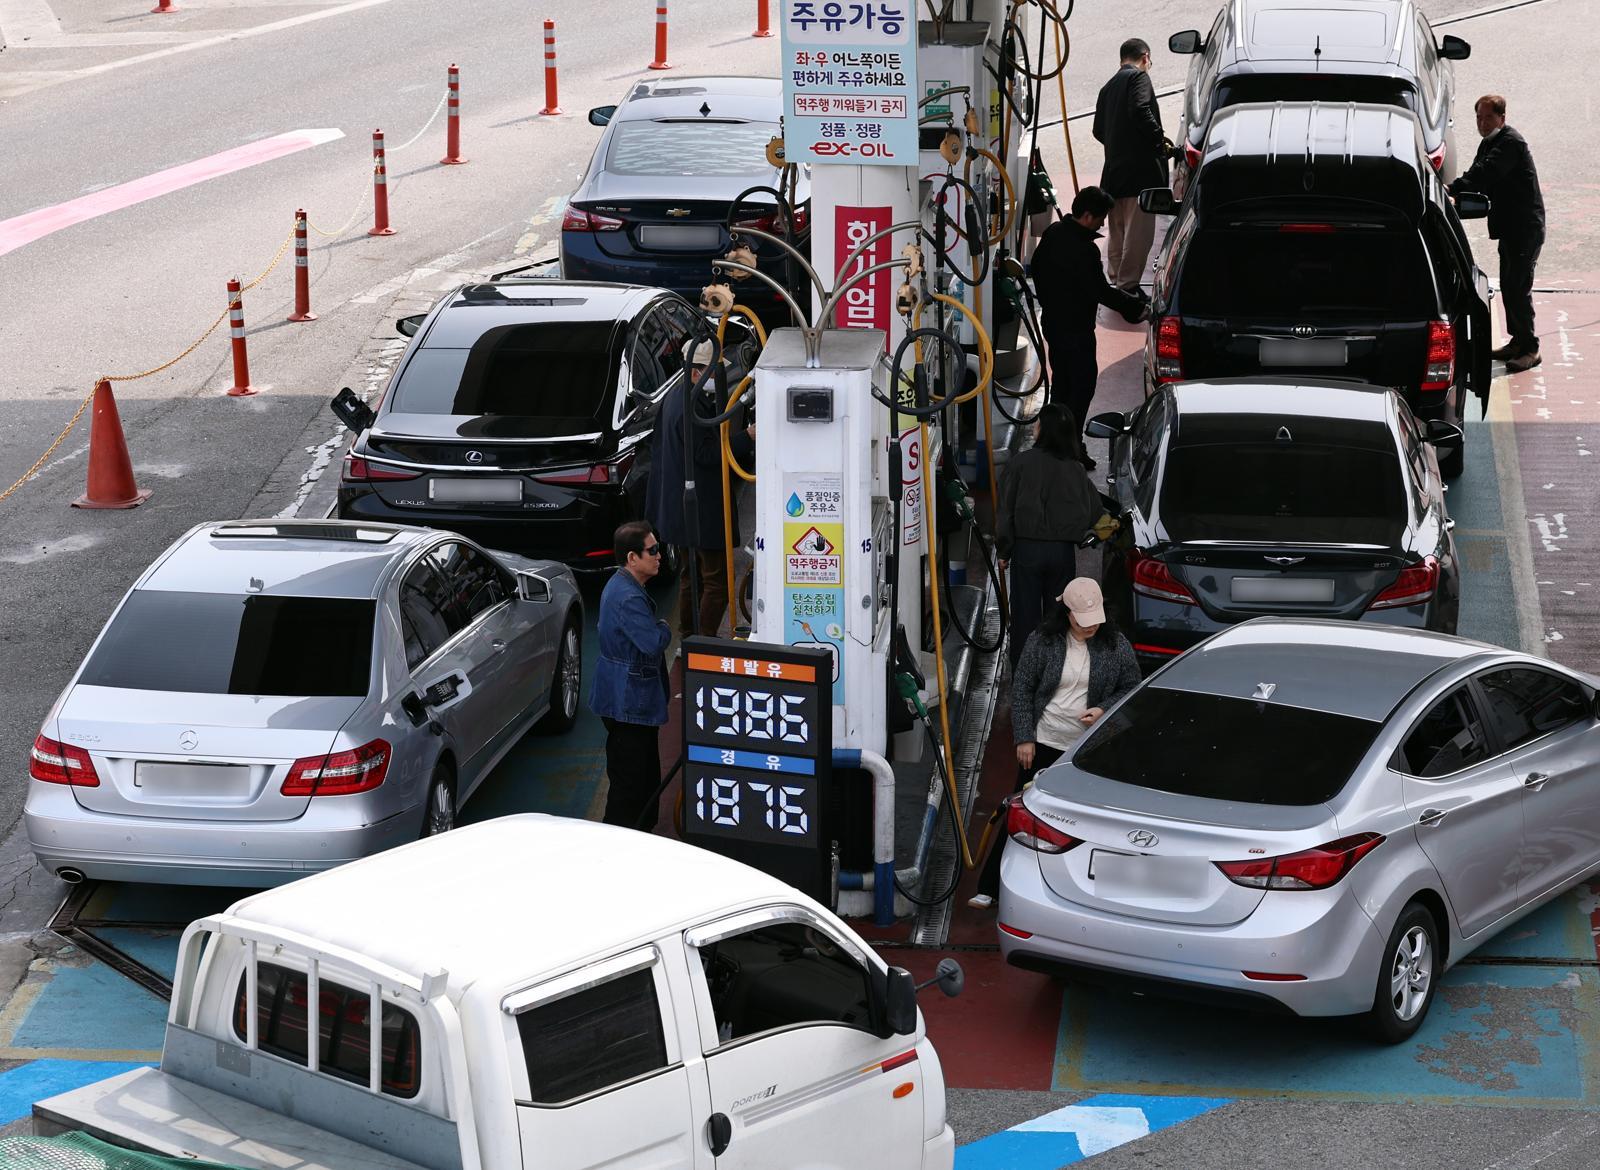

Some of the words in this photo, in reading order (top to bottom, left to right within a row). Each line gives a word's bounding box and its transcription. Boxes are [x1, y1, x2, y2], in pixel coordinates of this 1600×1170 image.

[790, 2, 905, 35] 주유가능
[832, 52, 902, 70] 어느쪽이든
[792, 70, 833, 87] 편하게
[837, 71, 907, 87] 주유하세요
[796, 97, 830, 113] 역주행
[833, 98, 877, 113] 끼워들기
[880, 99, 903, 114] 금지
[846, 220, 877, 329] 화기엄
[1295, 327, 1313, 335] KIA
[805, 491, 841, 503] 품질인증
[810, 502, 837, 513] 주유소
[756, 536, 765, 551] 14
[861, 538, 872, 553] 15
[789, 557, 838, 570] 역주행금지
[792, 593, 836, 605] 탄소중립
[792, 604, 836, 616] 실천하기
[696, 686, 809, 744] 1986
[696, 777, 809, 835] 1876
